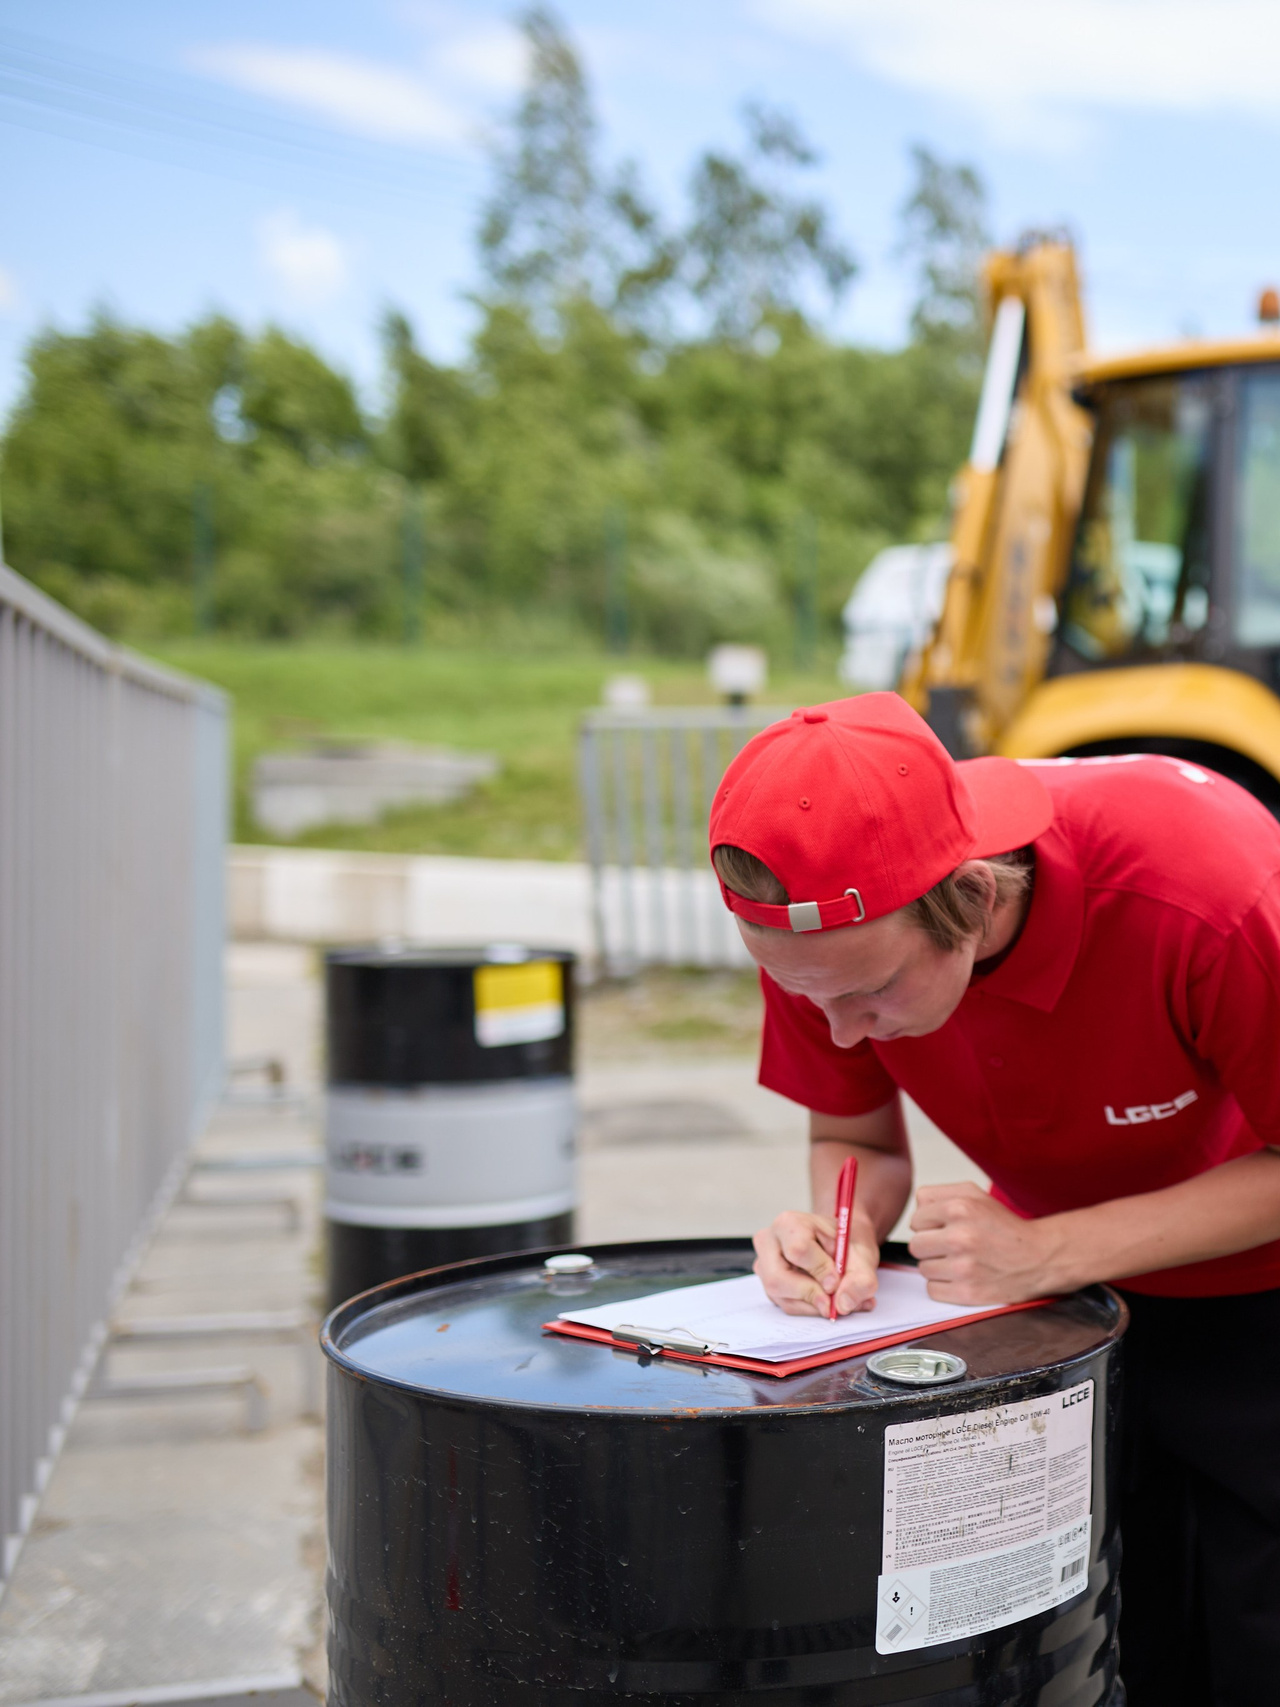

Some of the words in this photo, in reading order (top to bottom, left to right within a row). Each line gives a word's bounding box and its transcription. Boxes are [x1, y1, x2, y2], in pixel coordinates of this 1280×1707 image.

[1104, 1089, 1198, 1125] LGCE
[888, 1437, 914, 1446] Масло
[915, 1430, 950, 1442] моторное
[951, 1424, 972, 1435] LGCE
[974, 1420, 993, 1431] Diesel
[1020, 1413, 1029, 1422] Oil
